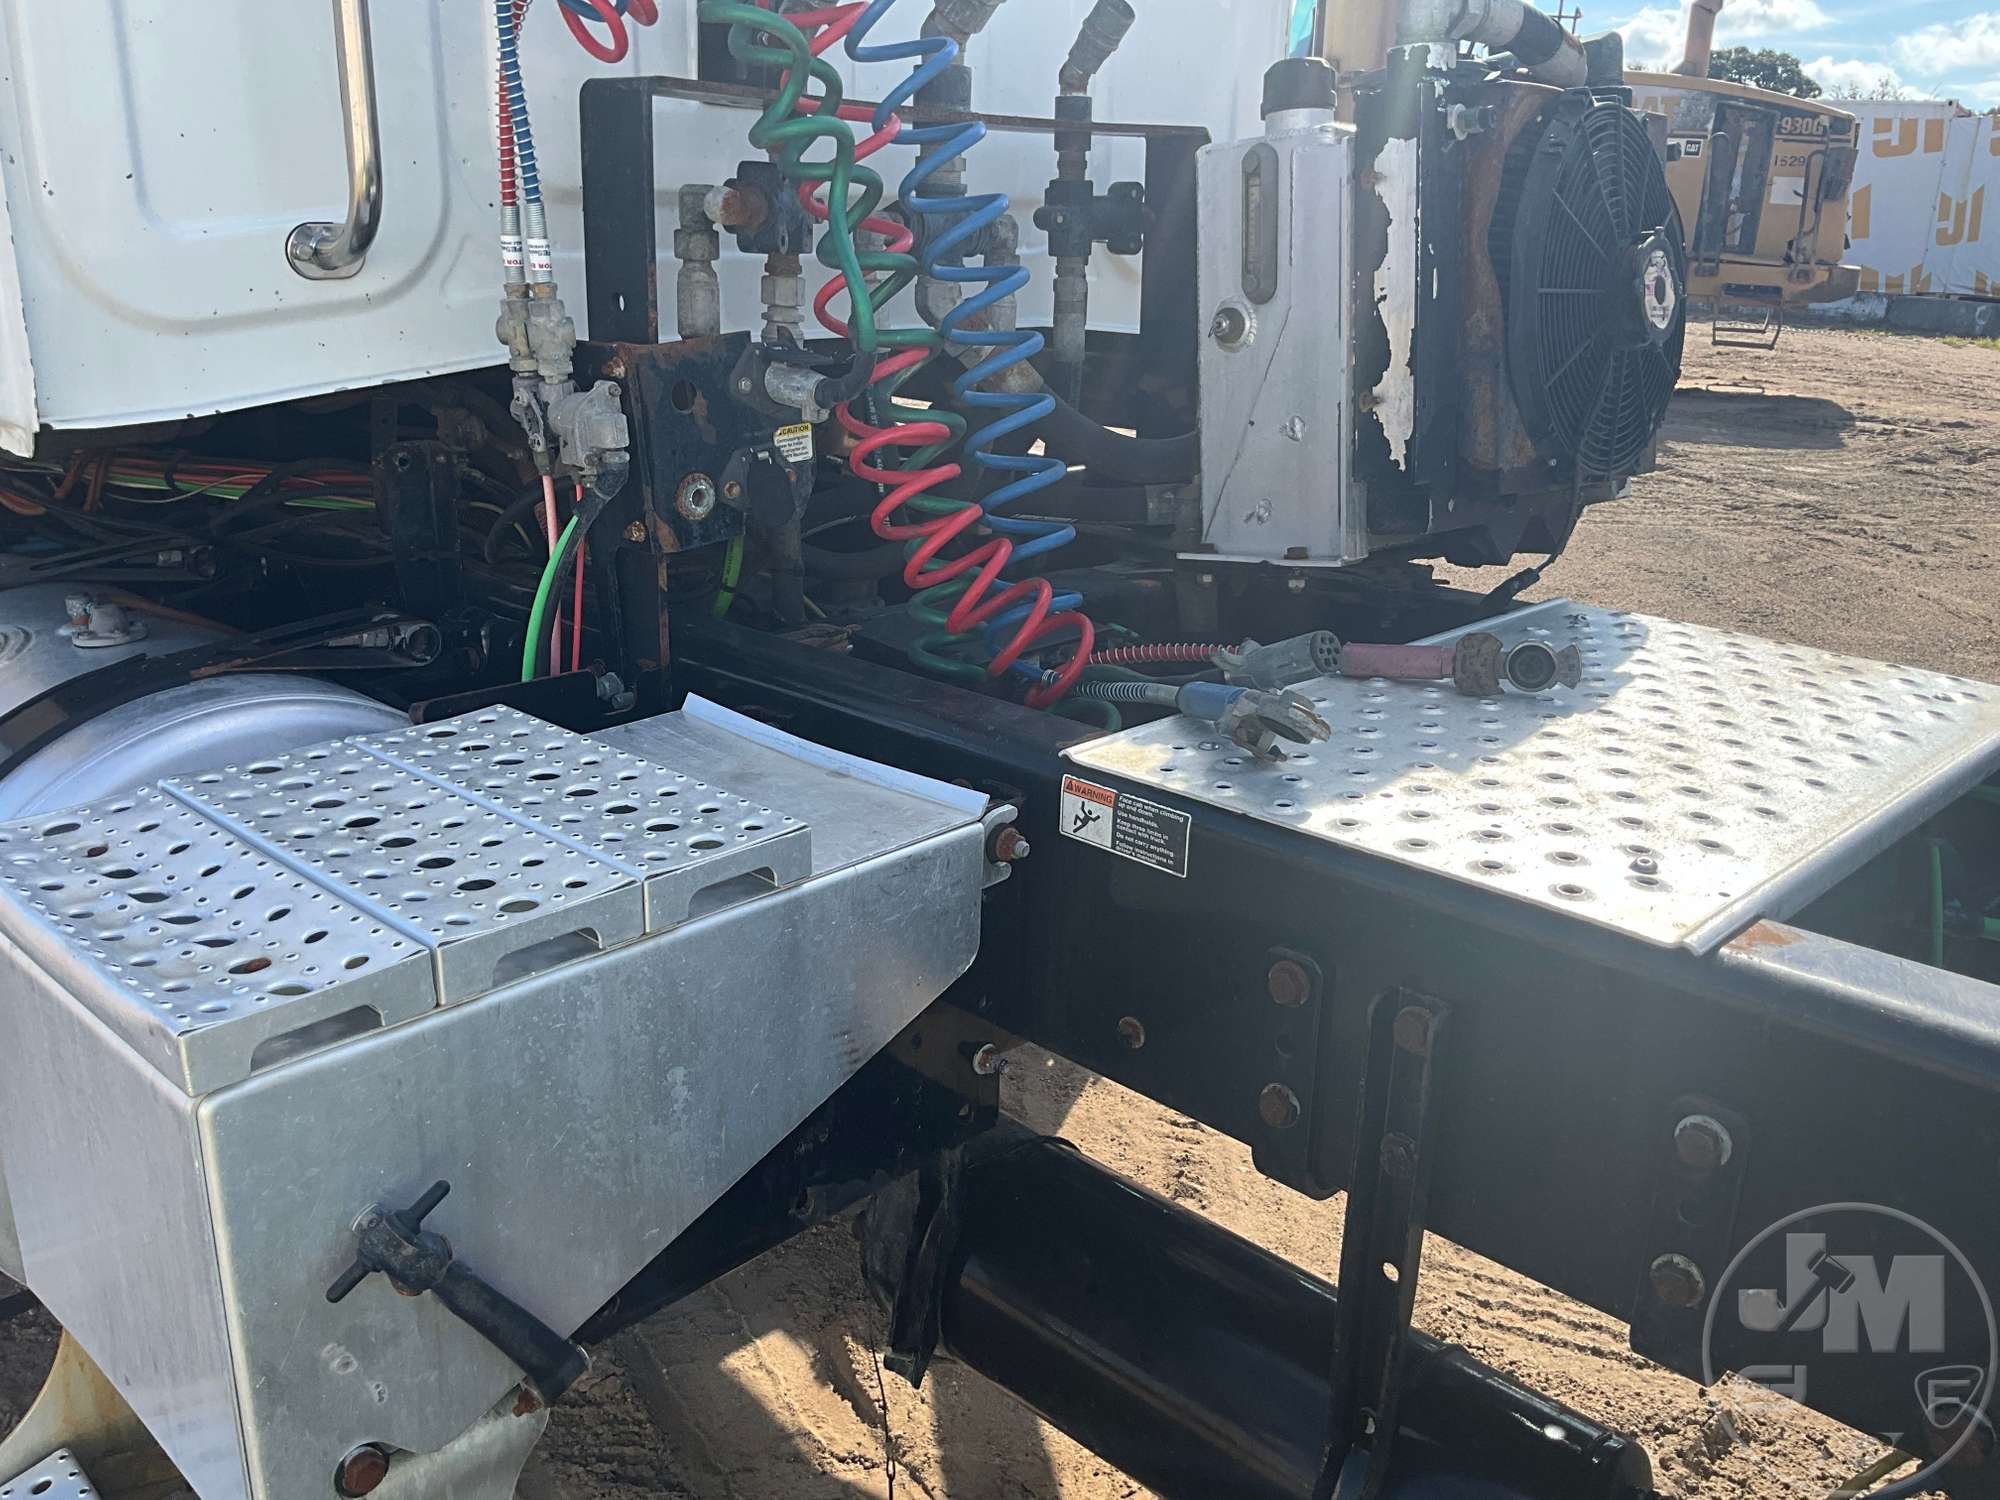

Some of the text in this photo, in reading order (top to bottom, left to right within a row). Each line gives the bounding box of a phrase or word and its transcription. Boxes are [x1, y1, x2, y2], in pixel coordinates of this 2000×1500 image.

[1781, 115, 1825, 137] 930G
[1686, 143, 1701, 153] CAT
[782, 424, 809, 435] CAUTION
[1073, 784, 1113, 805] WARNING
[1118, 795, 1132, 805] Face
[1143, 803, 1159, 813] when
[1159, 807, 1184, 822] climbing
[1126, 804, 1137, 812] and
[1117, 810, 1128, 818] Use
[1117, 818, 1131, 829] Keep
